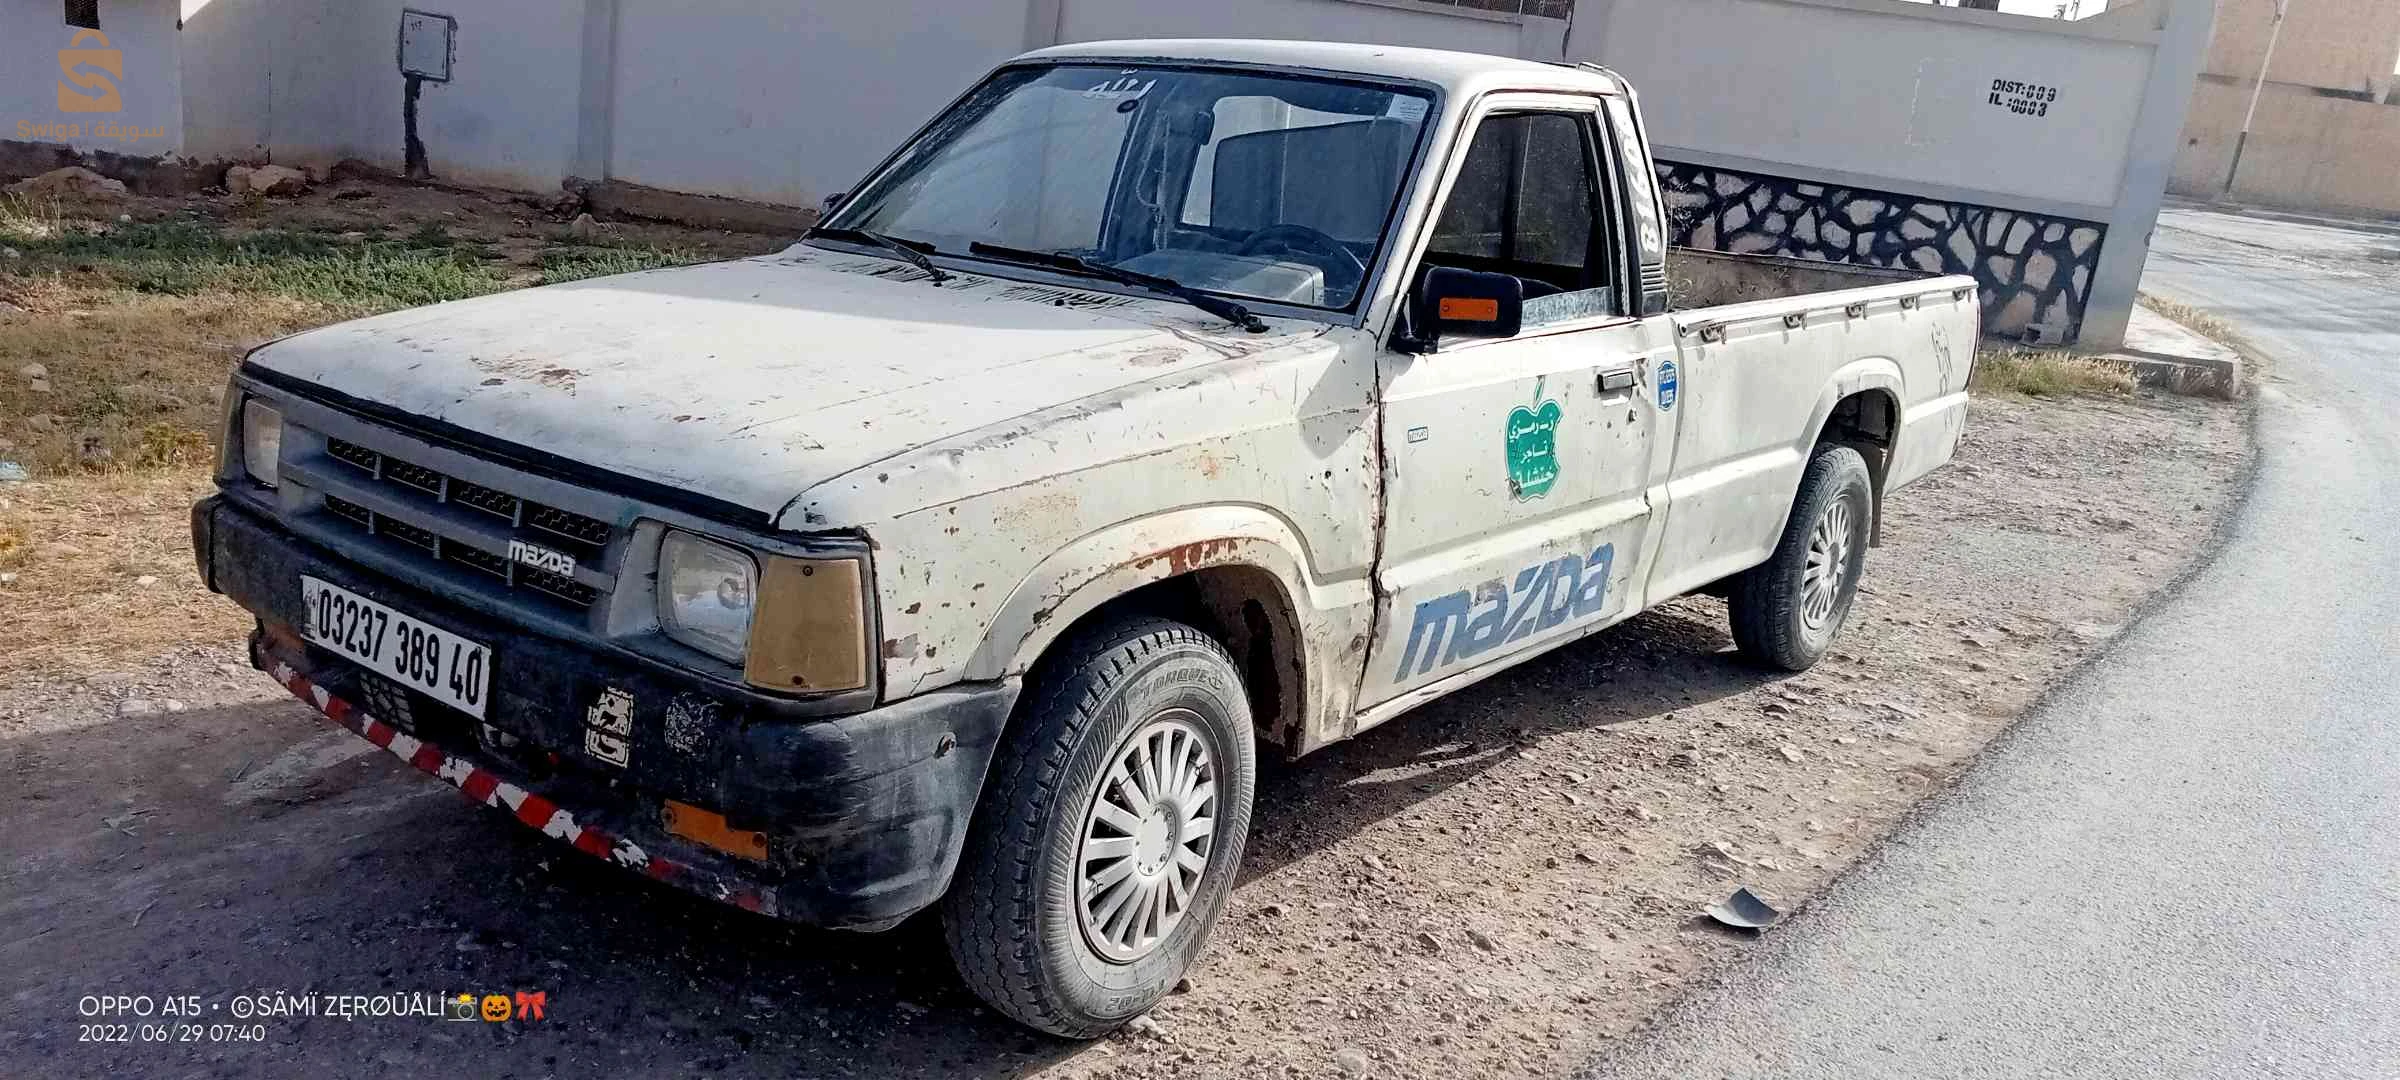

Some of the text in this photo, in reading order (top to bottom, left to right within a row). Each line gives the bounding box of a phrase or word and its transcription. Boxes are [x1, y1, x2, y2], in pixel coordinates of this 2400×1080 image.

[1520, 439, 1549, 465] تاجر
[318, 588, 482, 706] 03237 389 40
